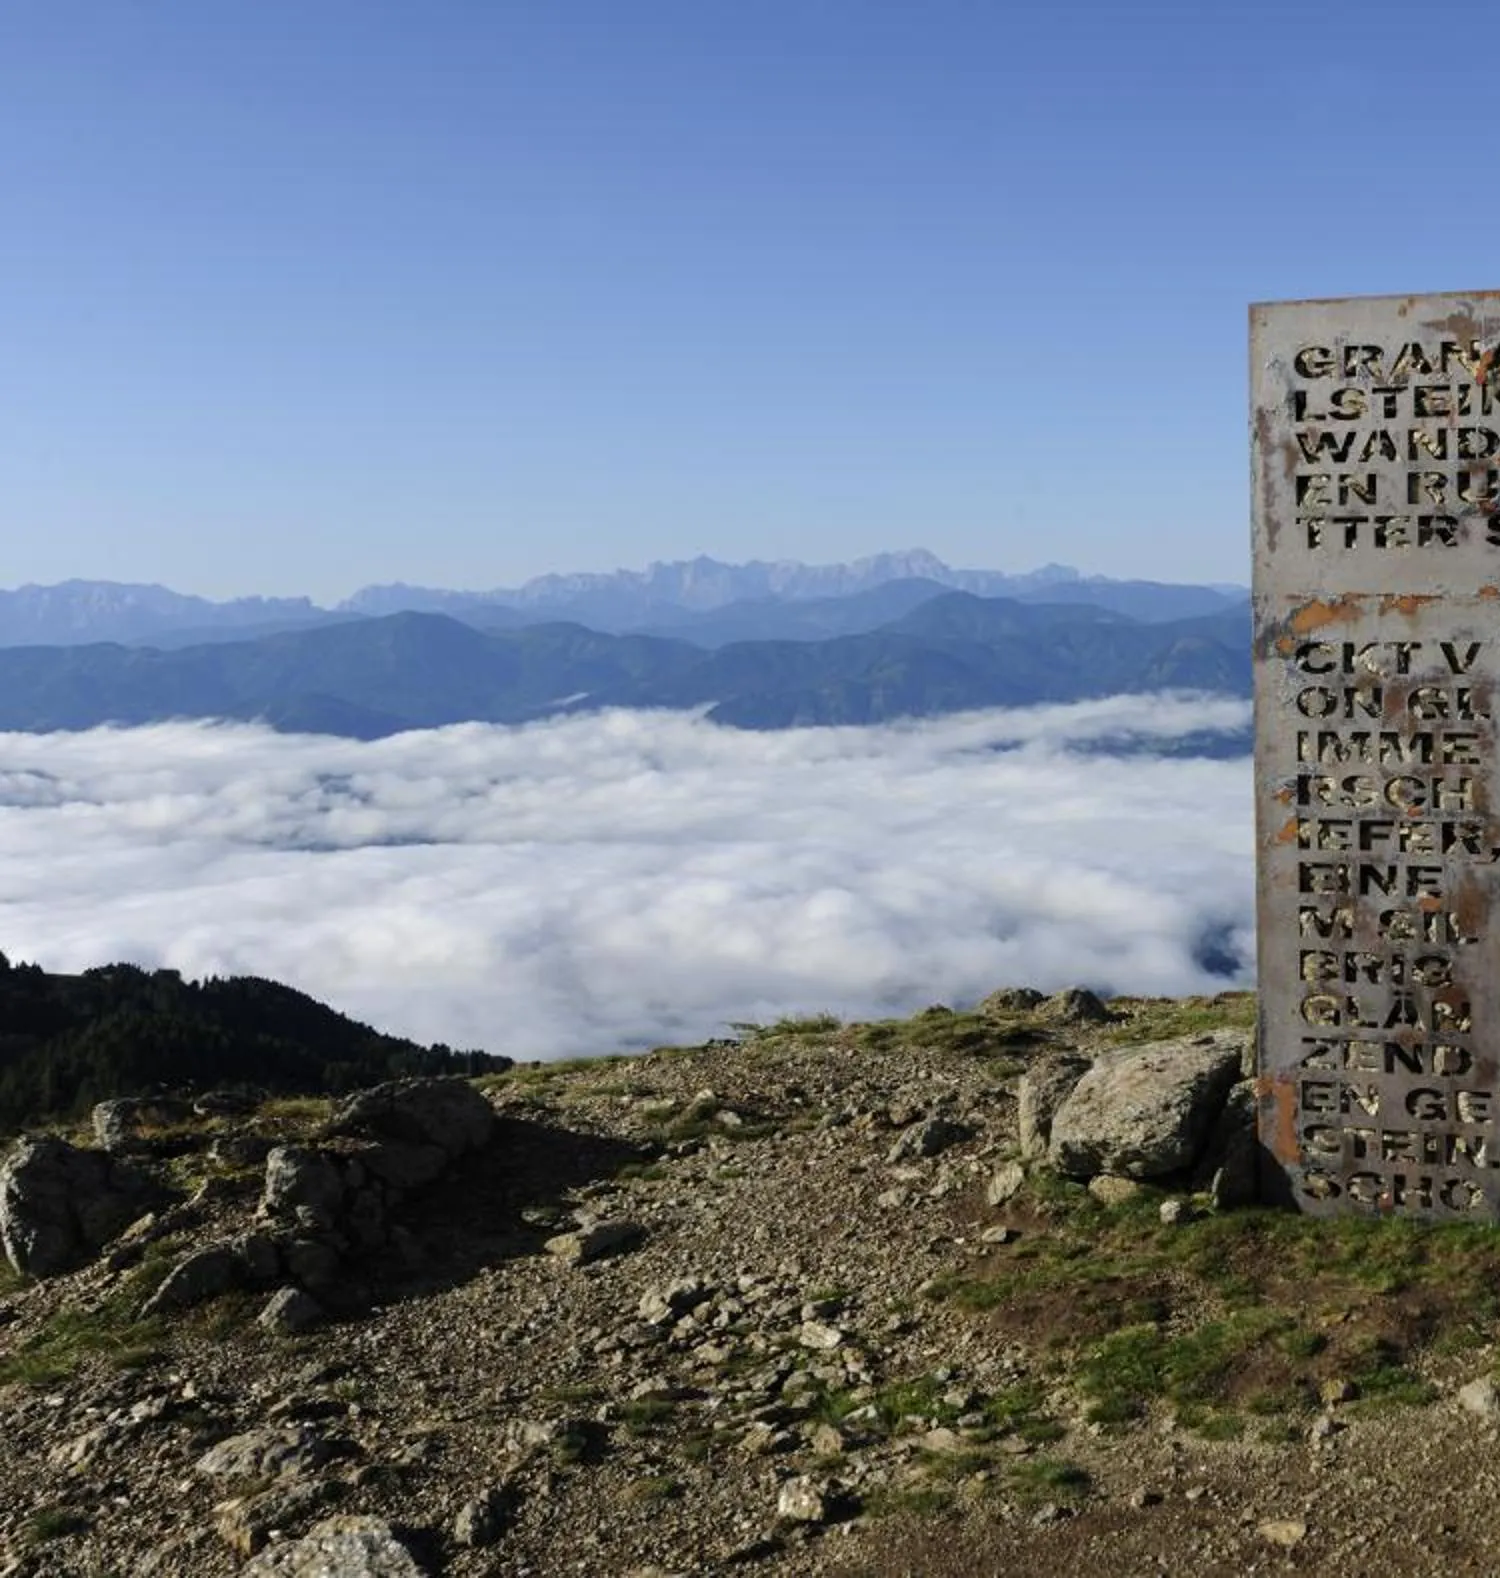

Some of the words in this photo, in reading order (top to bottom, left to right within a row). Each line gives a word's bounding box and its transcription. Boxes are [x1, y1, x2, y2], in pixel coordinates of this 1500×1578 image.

[1296, 473, 1377, 505] EN
[1296, 515, 1459, 548] TTER
[1295, 642, 1422, 676] CKT
[1440, 642, 1482, 674] V
[1297, 686, 1383, 719] ON
[1407, 686, 1490, 720] GL
[1297, 731, 1481, 764] IMME
[1297, 775, 1474, 810] RSCH
[1298, 862, 1442, 898] EINE
[1299, 906, 1353, 938] M
[1300, 1037, 1473, 1076] ZEND
[1301, 1080, 1380, 1116] EN
[1405, 1087, 1493, 1125] GE
[1301, 1168, 1485, 1211] SCHO
